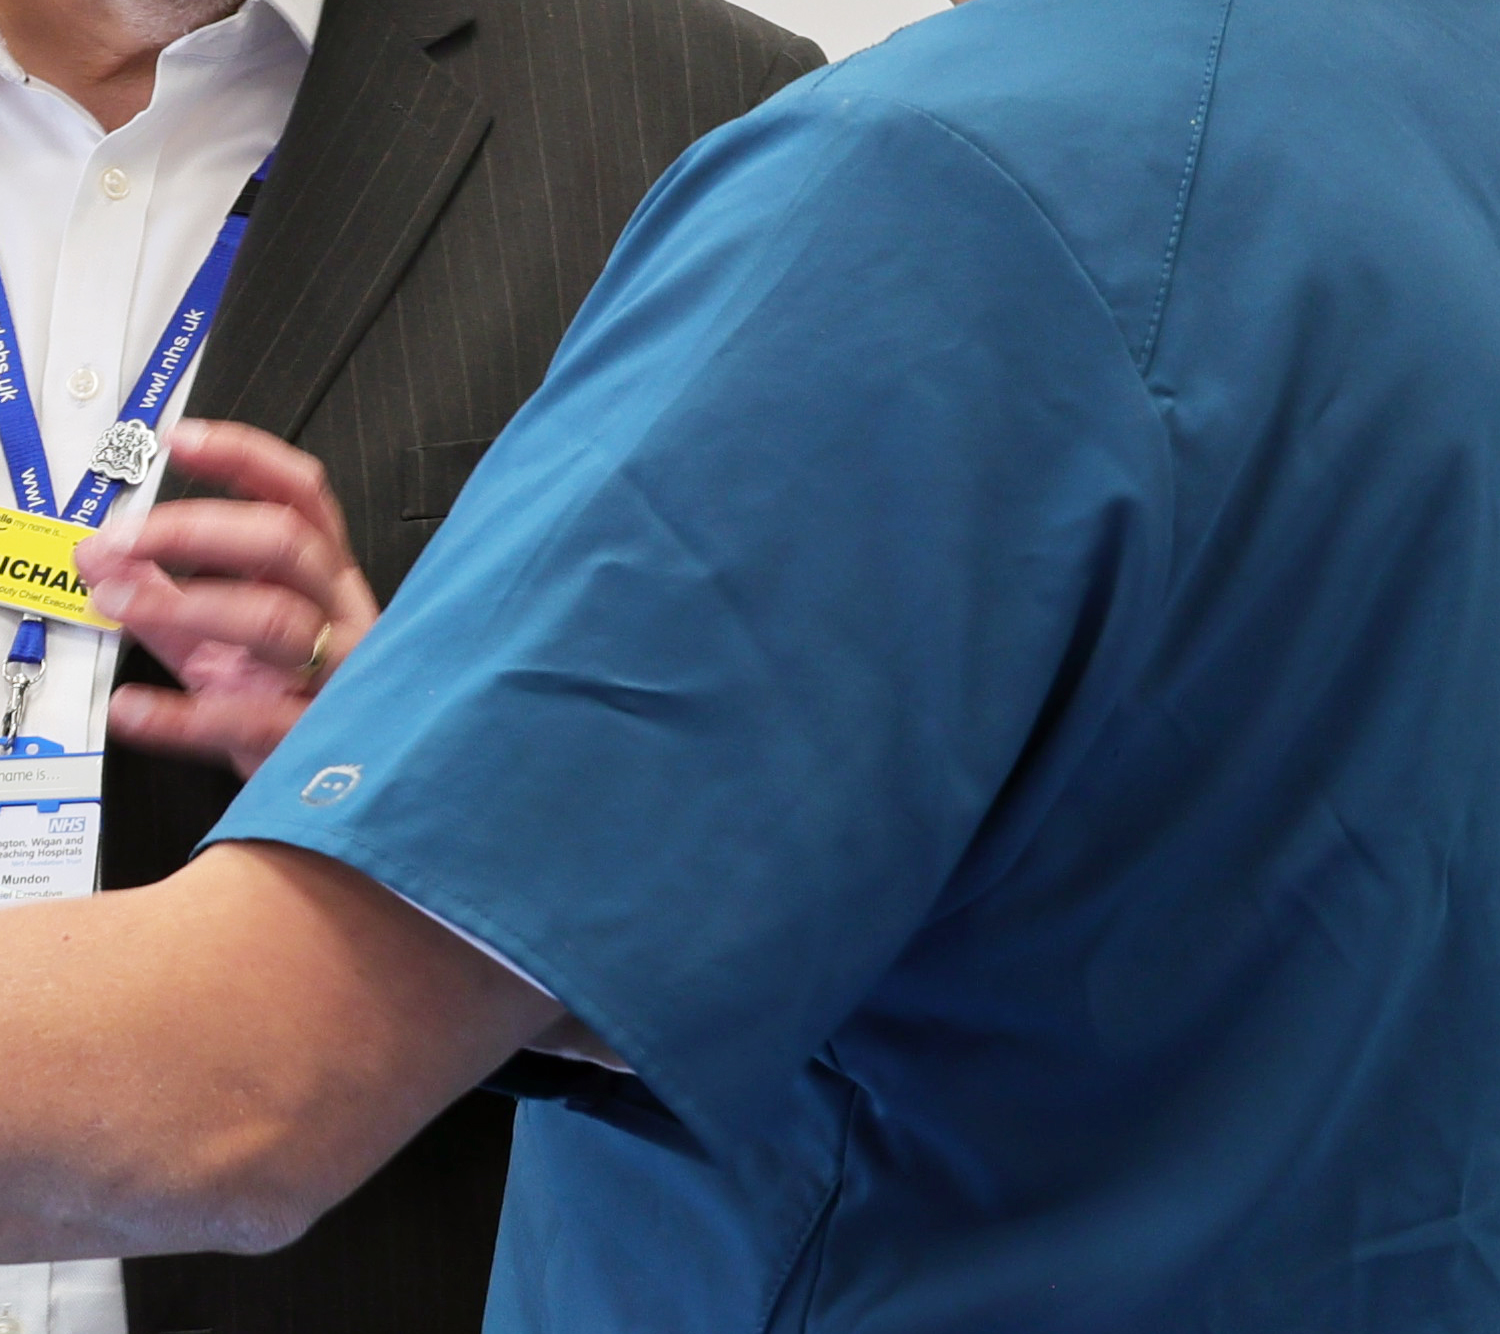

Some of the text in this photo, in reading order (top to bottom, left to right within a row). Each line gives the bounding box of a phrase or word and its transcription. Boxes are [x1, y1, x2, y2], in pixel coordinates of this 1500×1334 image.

[139, 308, 205, 409] wwl.nhs.uk
[13, 520, 27, 531] my
[27, 524, 51, 535] name
[18, 589, 43, 602] Chief
[43, 596, 85, 614] Executive
[50, 817, 85, 833] NHS
[31, 837, 63, 849] Wigan
[65, 836, 84, 845] and
[37, 847, 83, 858] Hospitals
[1, 874, 50, 885] Mundon
